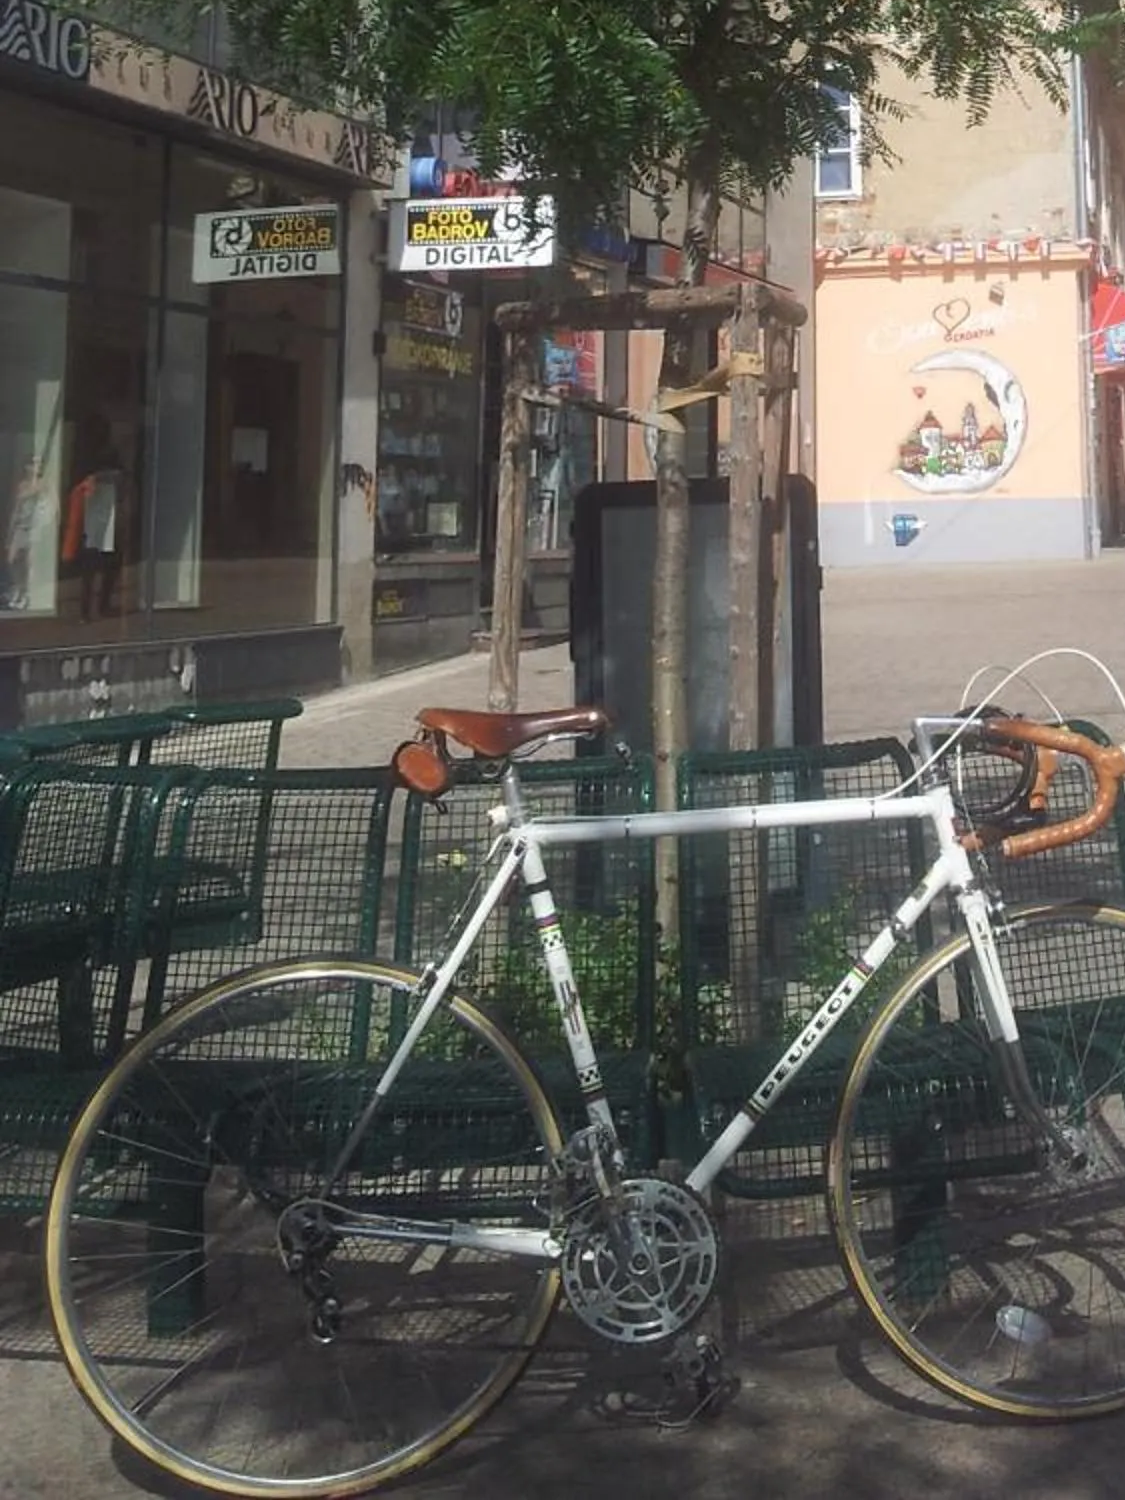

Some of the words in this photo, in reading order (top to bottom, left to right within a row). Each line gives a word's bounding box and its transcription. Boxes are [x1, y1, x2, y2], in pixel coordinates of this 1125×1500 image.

[427, 209, 473, 225] FOTO
[411, 221, 489, 240] BADROV
[425, 246, 514, 266] DIGITAL
[760, 981, 853, 1100] PEUGEOT
